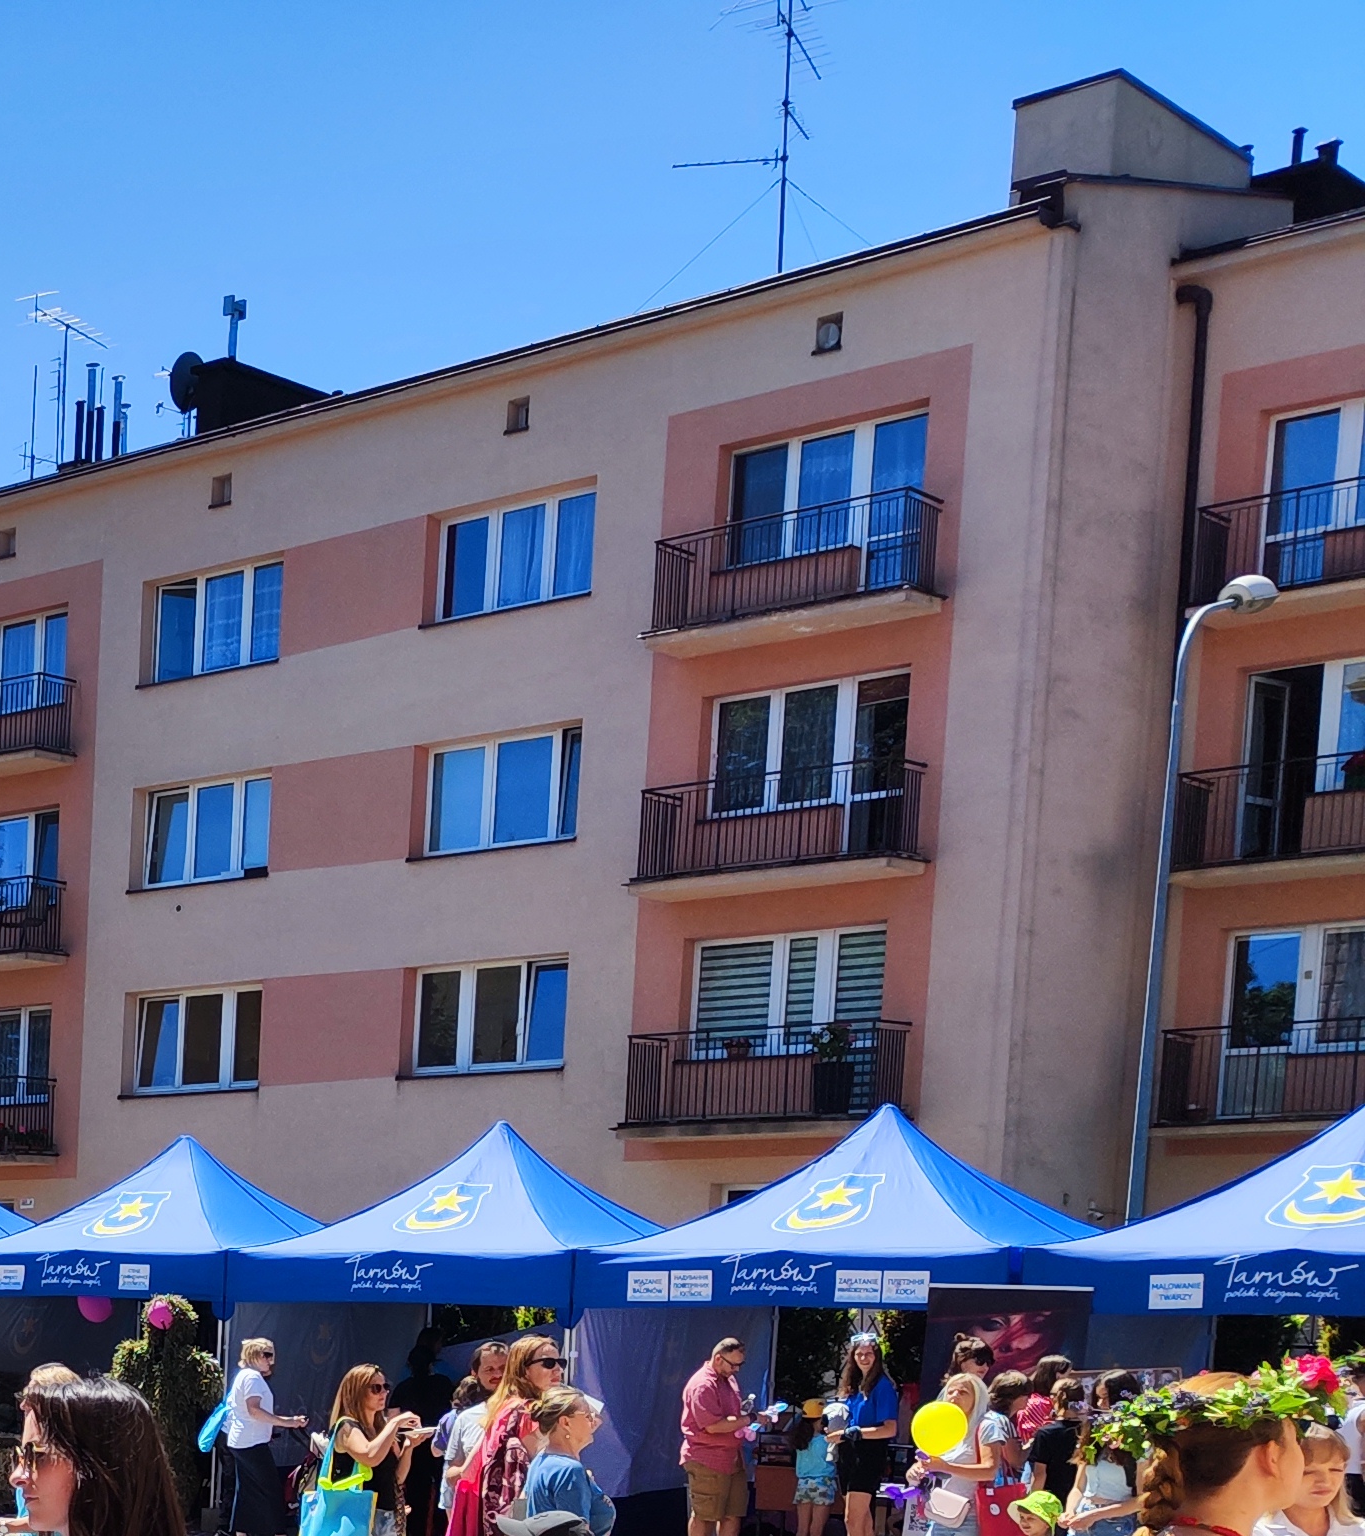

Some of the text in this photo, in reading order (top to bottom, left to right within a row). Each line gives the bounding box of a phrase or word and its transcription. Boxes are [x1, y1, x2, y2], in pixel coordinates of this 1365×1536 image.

[36, 1252, 111, 1278] Tarnów
[344, 1254, 433, 1281] Tarnów
[721, 1252, 832, 1283] Tarnów
[1213, 1254, 1360, 1289] Tarnów
[1151, 1282, 1202, 1291] MALOWANIE
[1158, 1293, 1194, 1301] TWARZY
